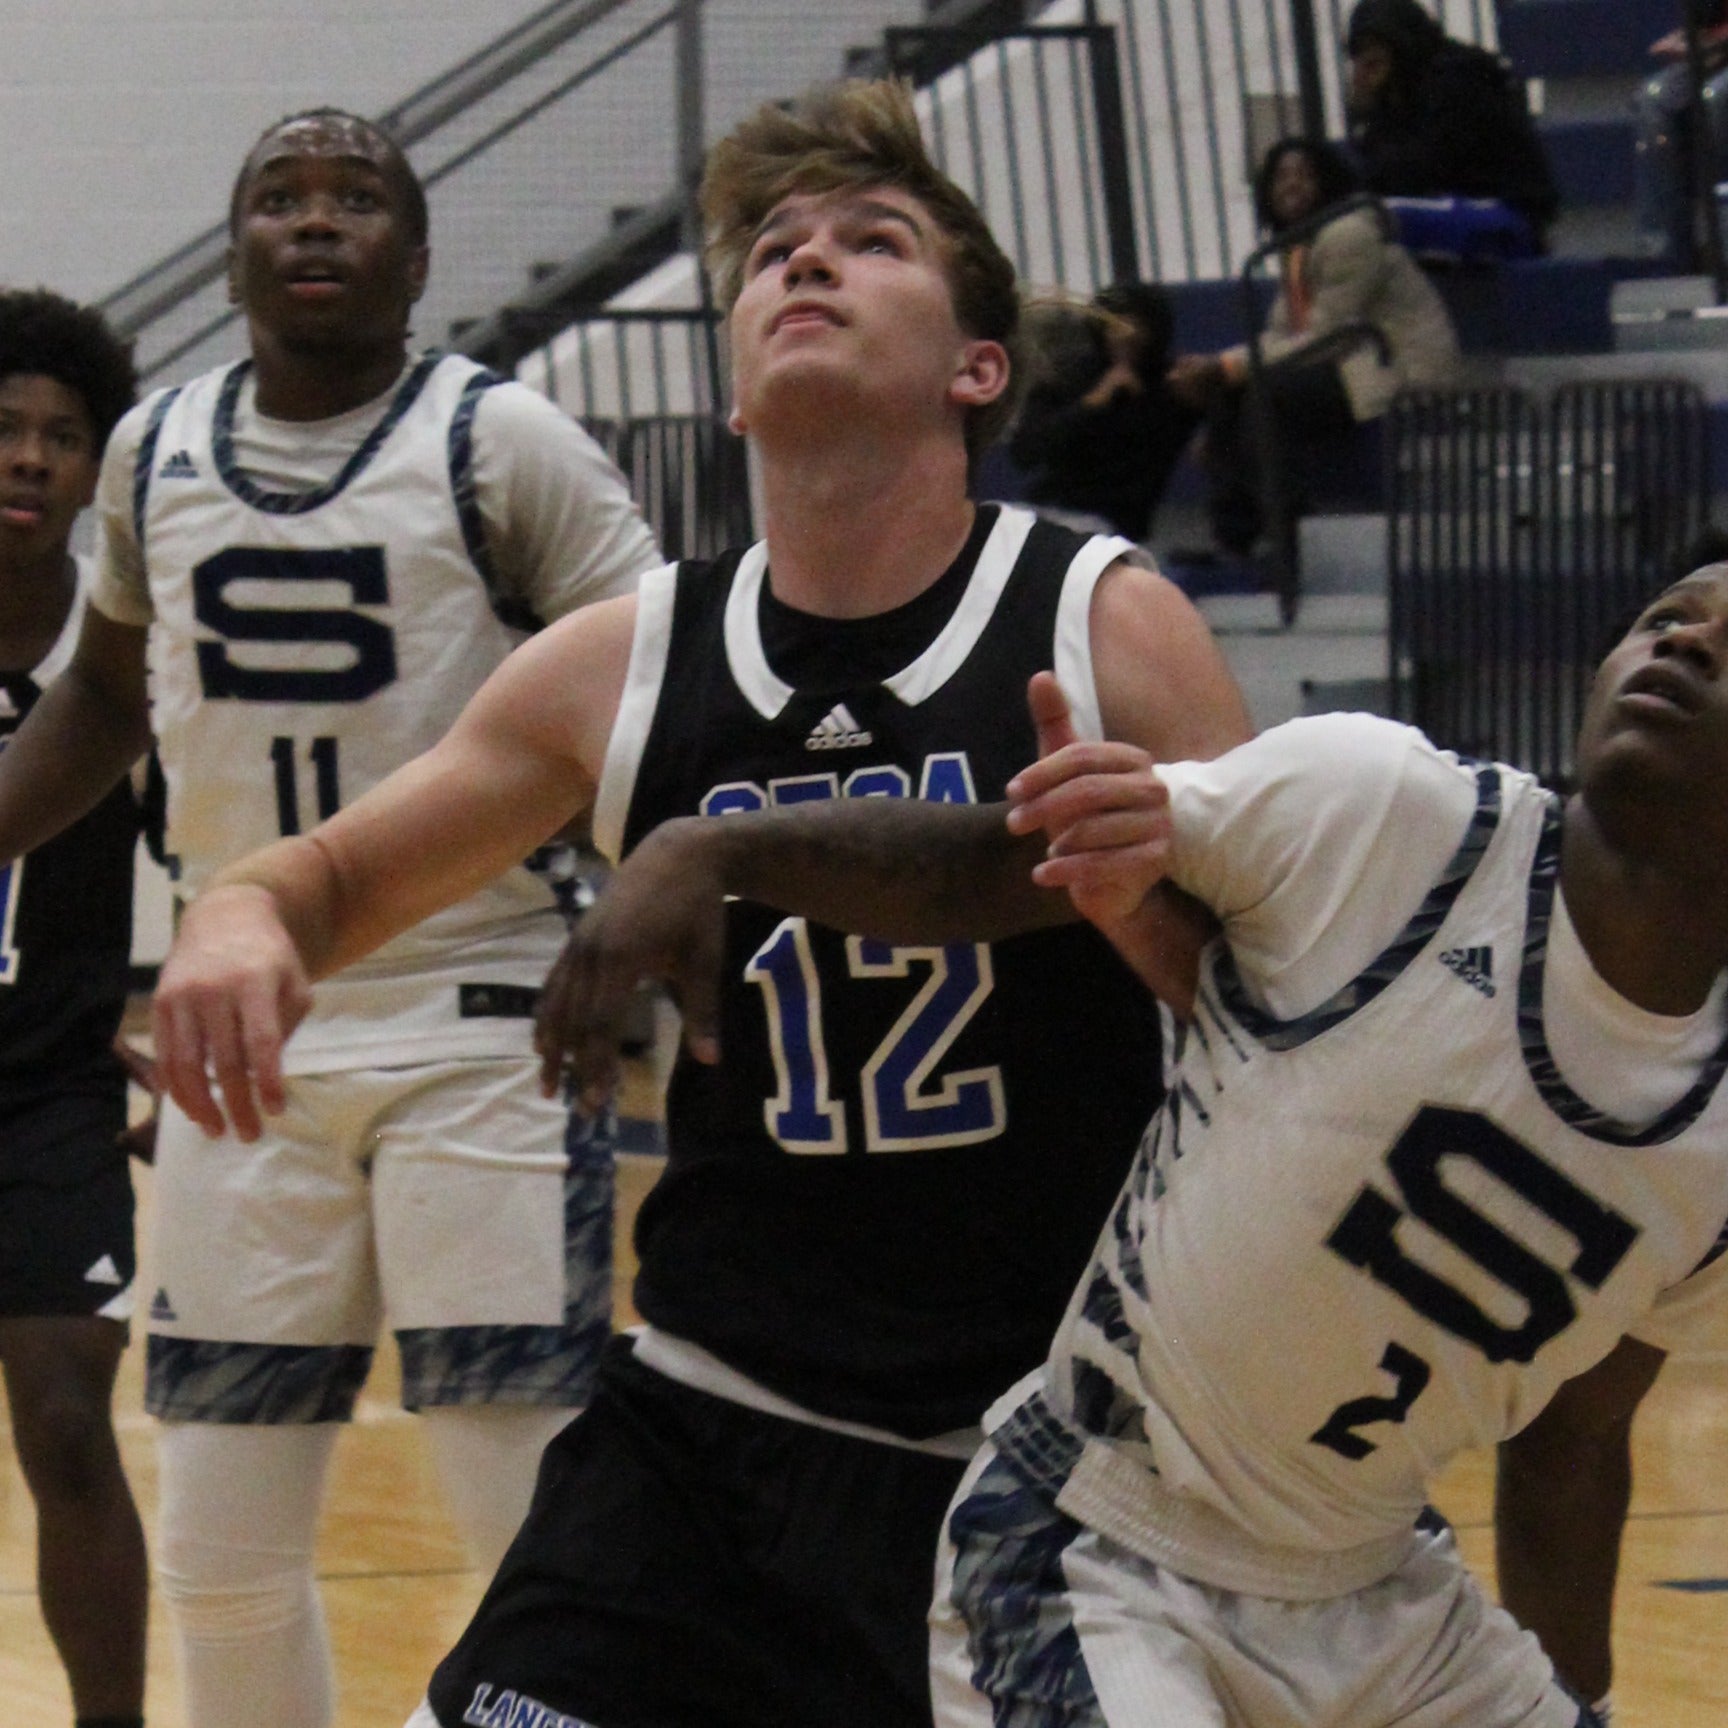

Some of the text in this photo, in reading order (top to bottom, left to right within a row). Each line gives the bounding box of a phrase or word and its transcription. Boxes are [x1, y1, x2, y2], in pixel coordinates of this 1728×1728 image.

[192, 546, 397, 702] S
[270, 736, 340, 837] 11
[743, 916, 1007, 1154] 12
[1323, 1105, 1641, 1366] S
[1309, 1341, 1431, 1460] 2
